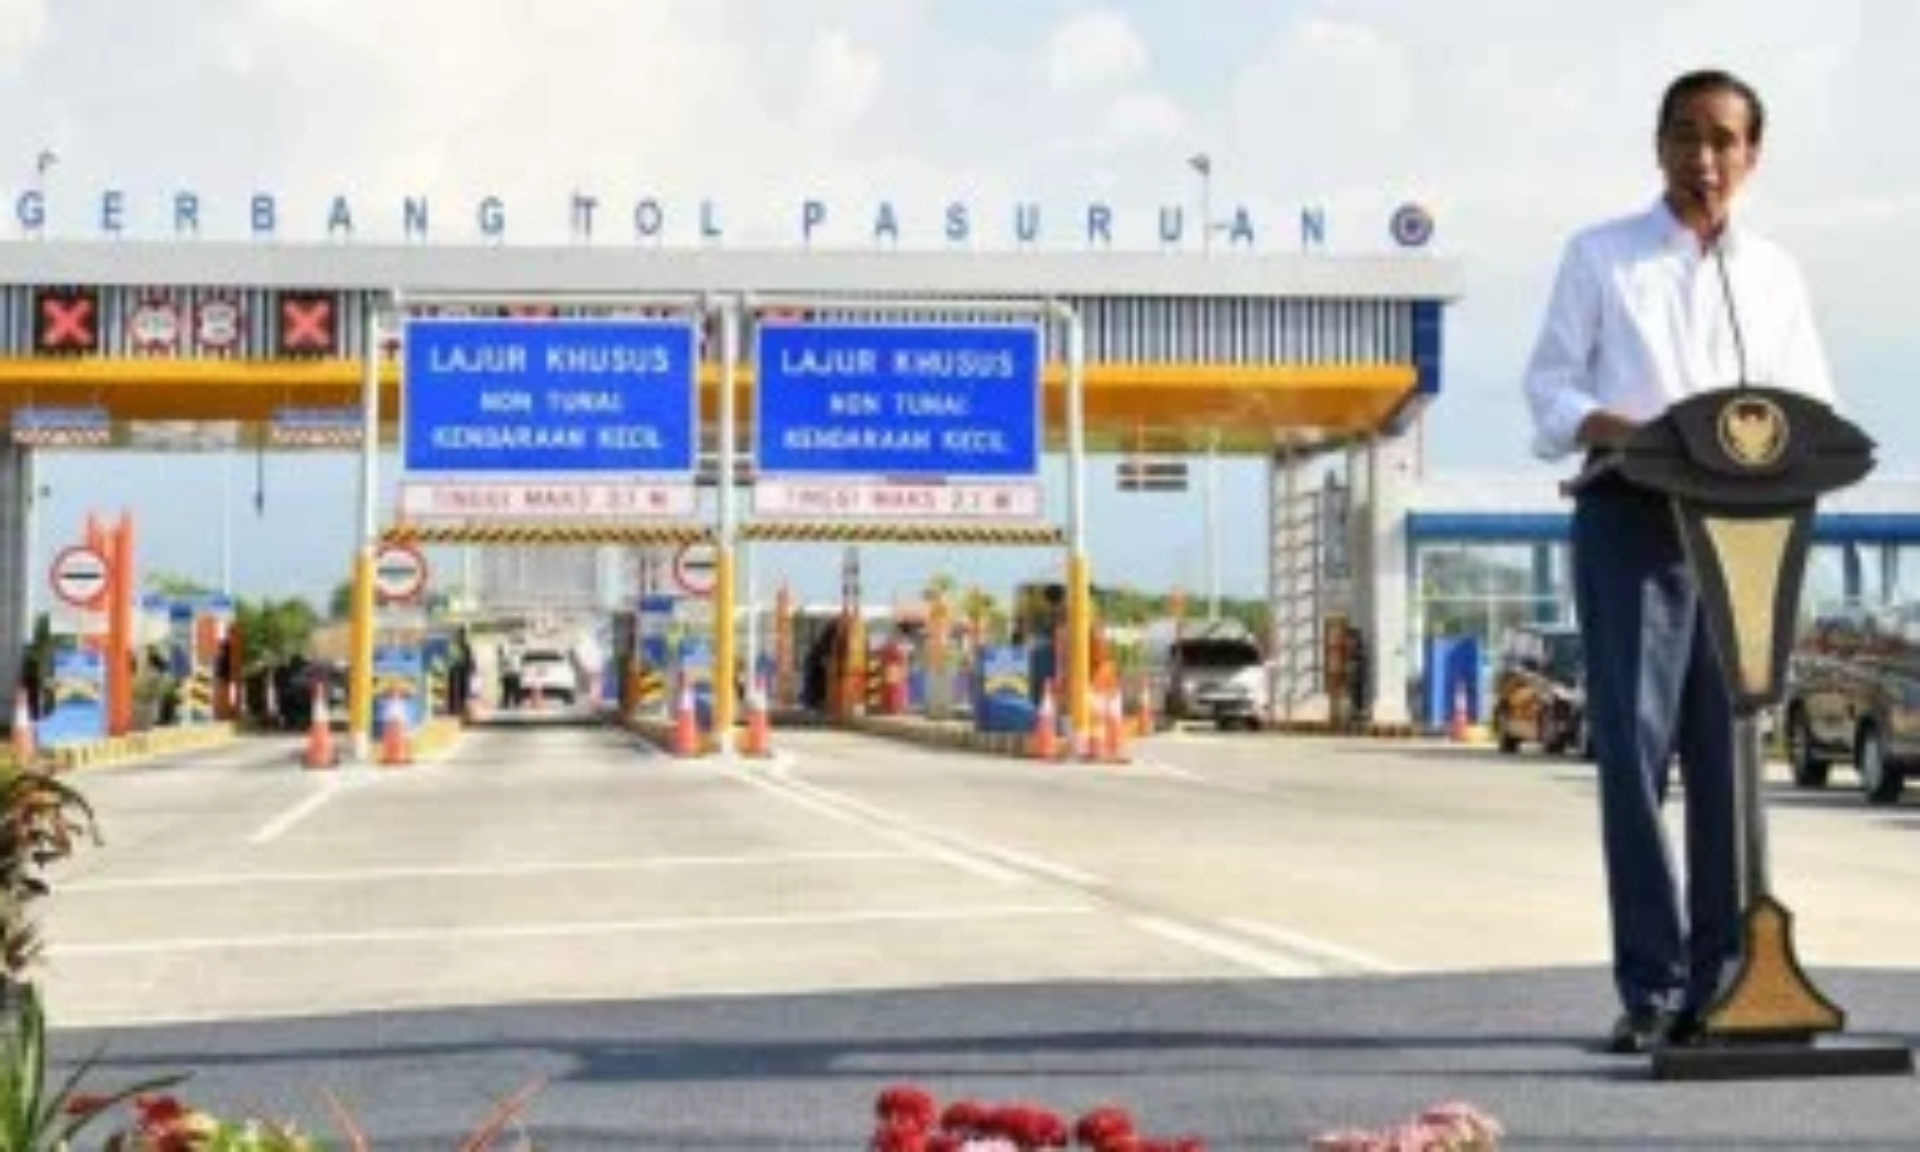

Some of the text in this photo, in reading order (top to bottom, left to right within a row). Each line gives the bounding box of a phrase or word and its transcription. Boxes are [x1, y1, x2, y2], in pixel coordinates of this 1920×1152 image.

[16, 190, 1325, 243] GERBANG TOL PASURUAN
[430, 345, 669, 374] LAJUR KHUSUS
[780, 349, 1014, 378] LAJUR KHUSUS
[480, 391, 533, 413] NON
[829, 392, 880, 416] NON
